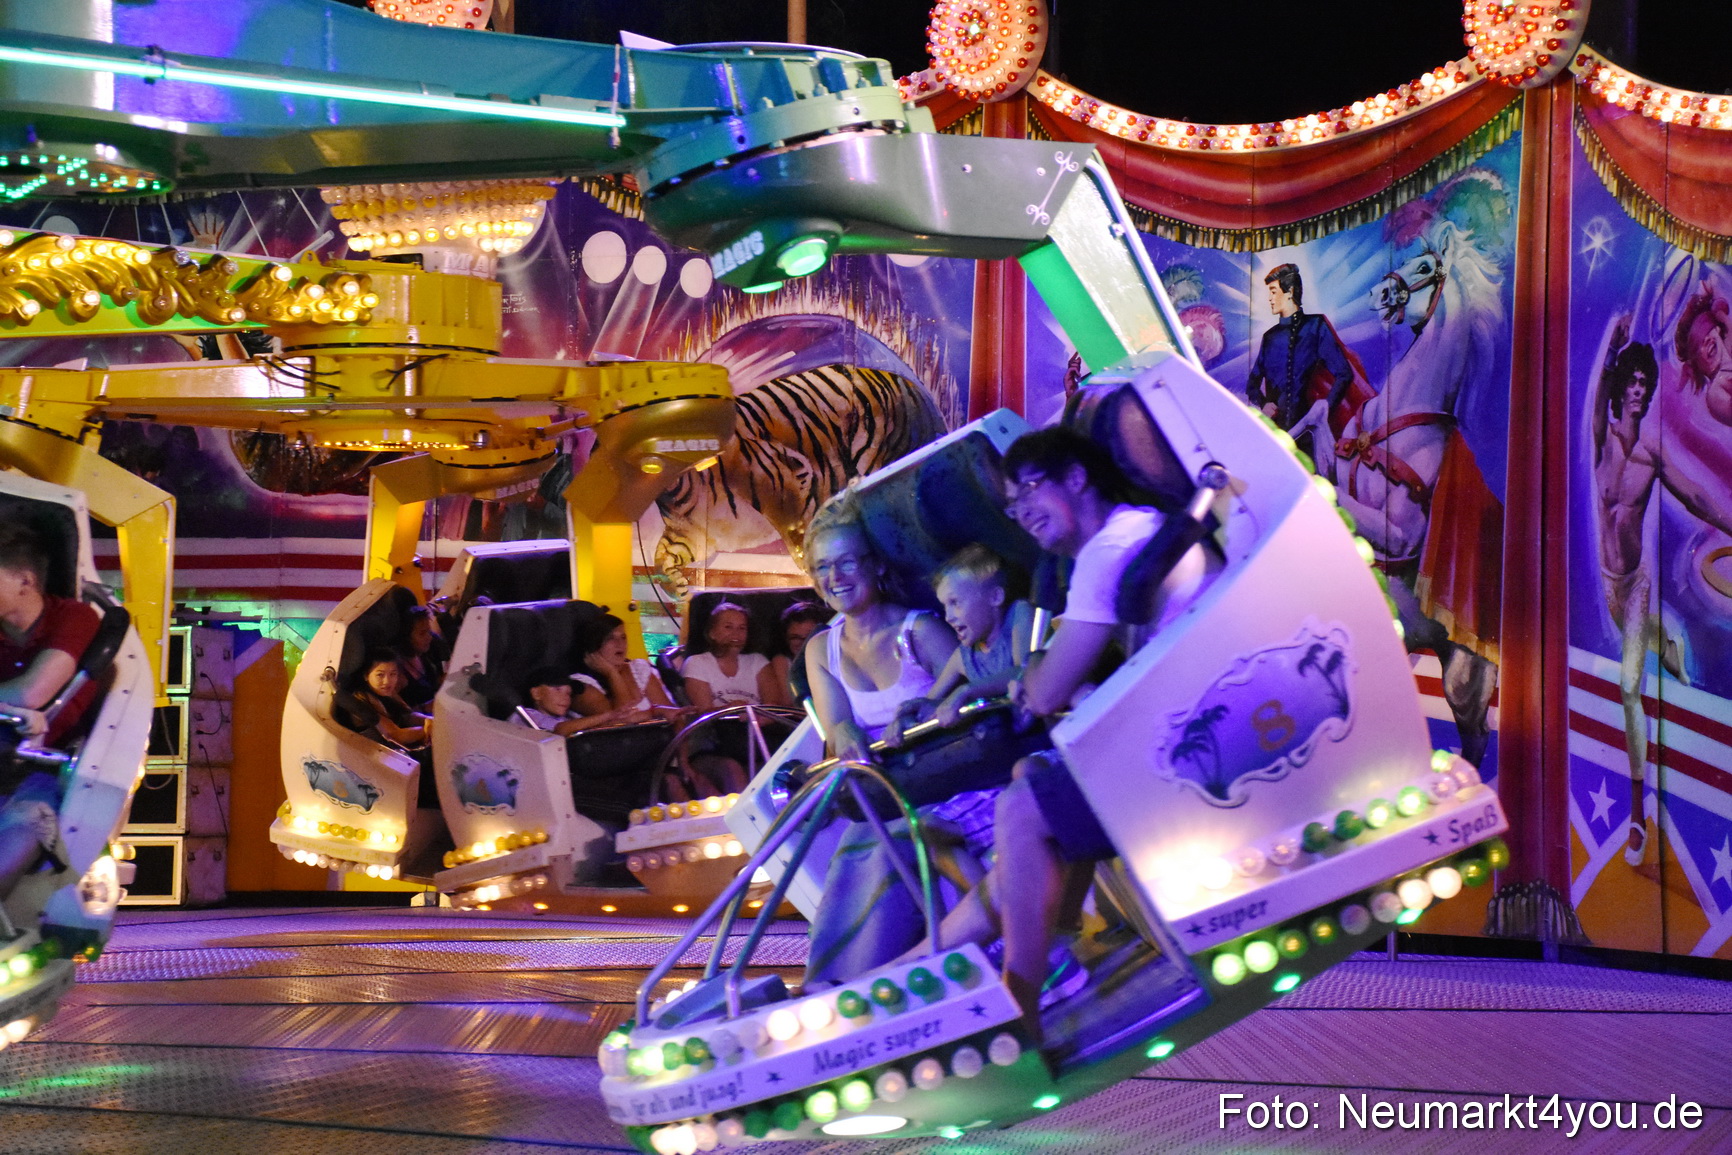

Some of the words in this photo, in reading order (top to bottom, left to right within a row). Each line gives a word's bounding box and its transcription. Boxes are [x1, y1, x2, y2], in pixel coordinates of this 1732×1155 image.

[656, 439, 719, 452] MAGIC
[1252, 699, 1295, 752] 8
[1208, 900, 1268, 932] super
[1448, 804, 1498, 845] Spaß
[669, 1085, 696, 1111] und
[812, 1039, 877, 1076] Magic
[884, 1019, 943, 1051] super
